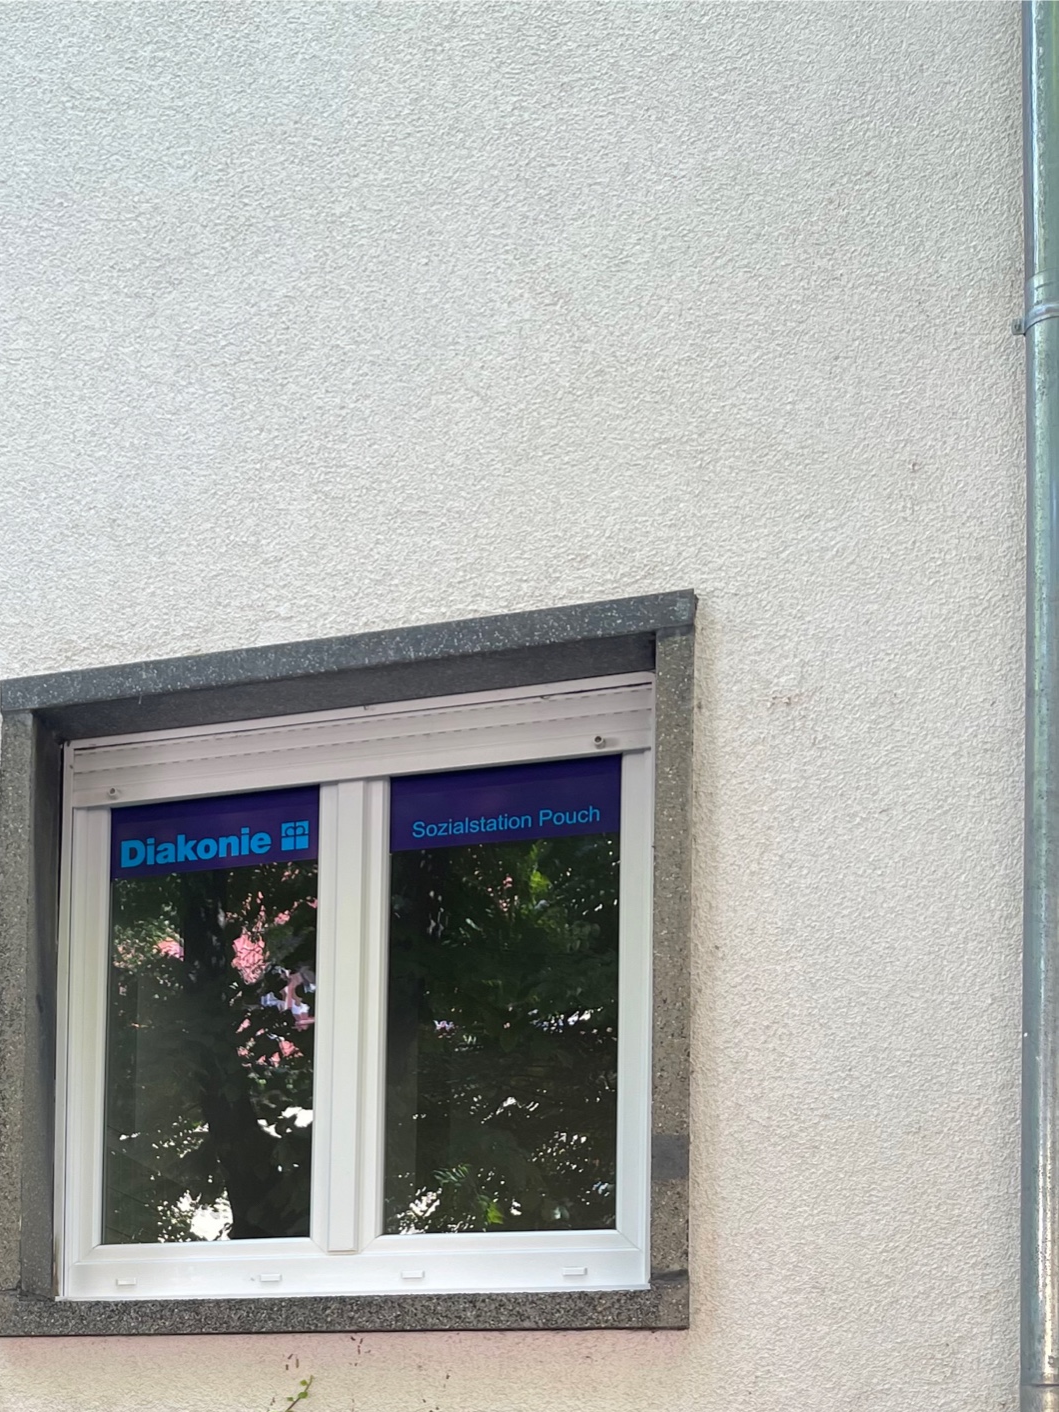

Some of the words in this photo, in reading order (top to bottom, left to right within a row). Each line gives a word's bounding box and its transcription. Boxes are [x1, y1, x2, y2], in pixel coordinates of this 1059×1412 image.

[412, 812, 532, 839] Sozialstation
[539, 805, 601, 825] Pouch
[121, 827, 272, 868] Diakonie
